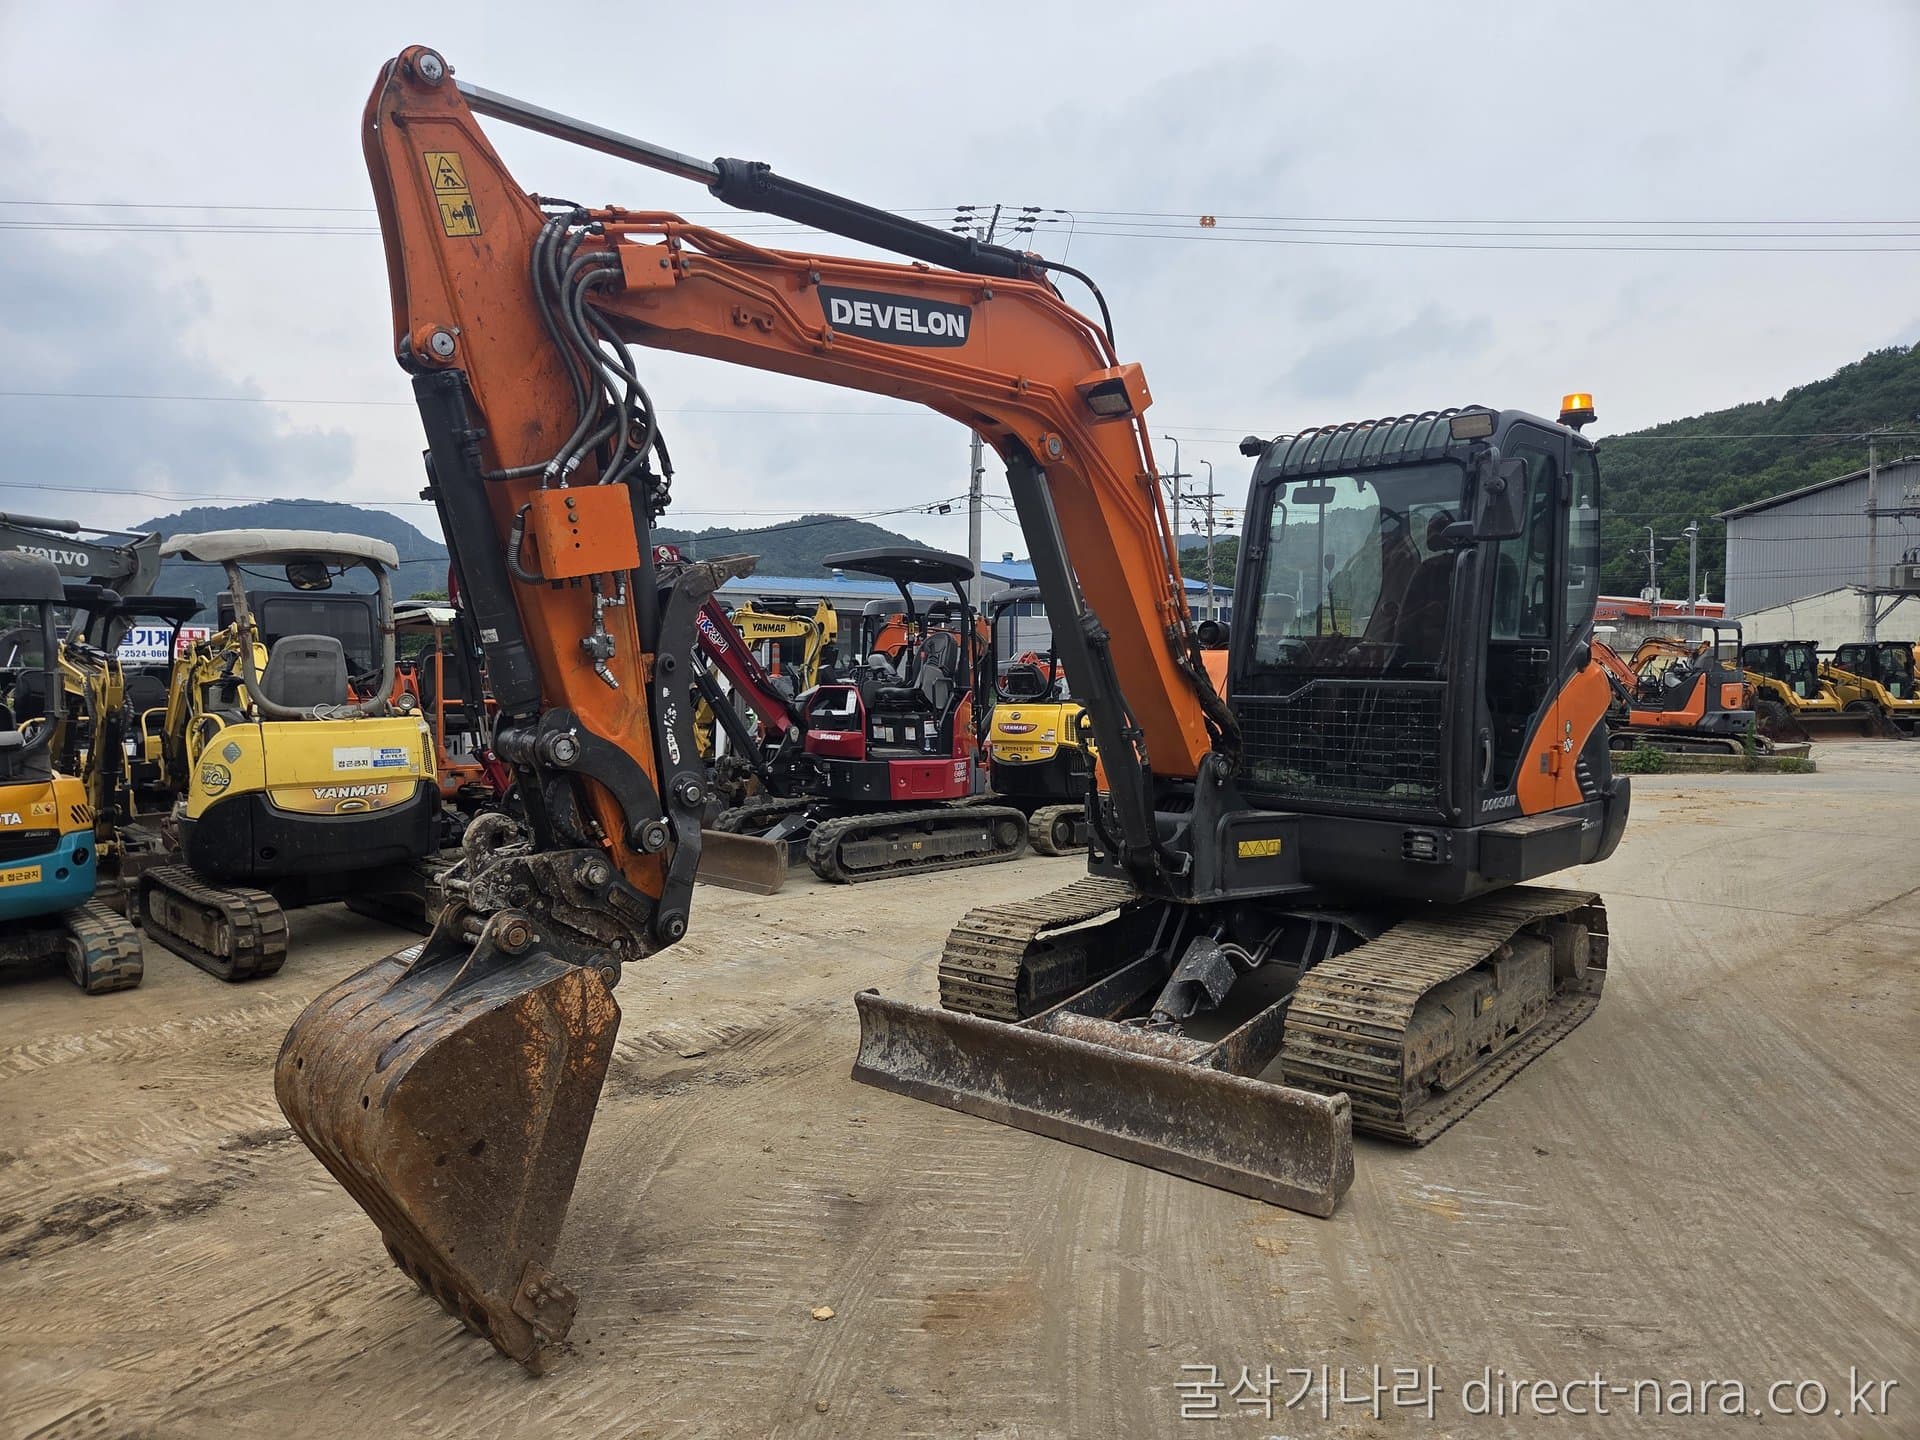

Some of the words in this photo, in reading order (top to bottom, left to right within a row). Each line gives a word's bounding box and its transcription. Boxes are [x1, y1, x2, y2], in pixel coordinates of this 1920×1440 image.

[830, 298, 965, 338] DEVELON
[752, 623, 786, 633] YANMAR
[312, 783, 388, 799] YANMAR
[1481, 794, 1516, 812] DOOSAN
[0, 812, 23, 825] TA
